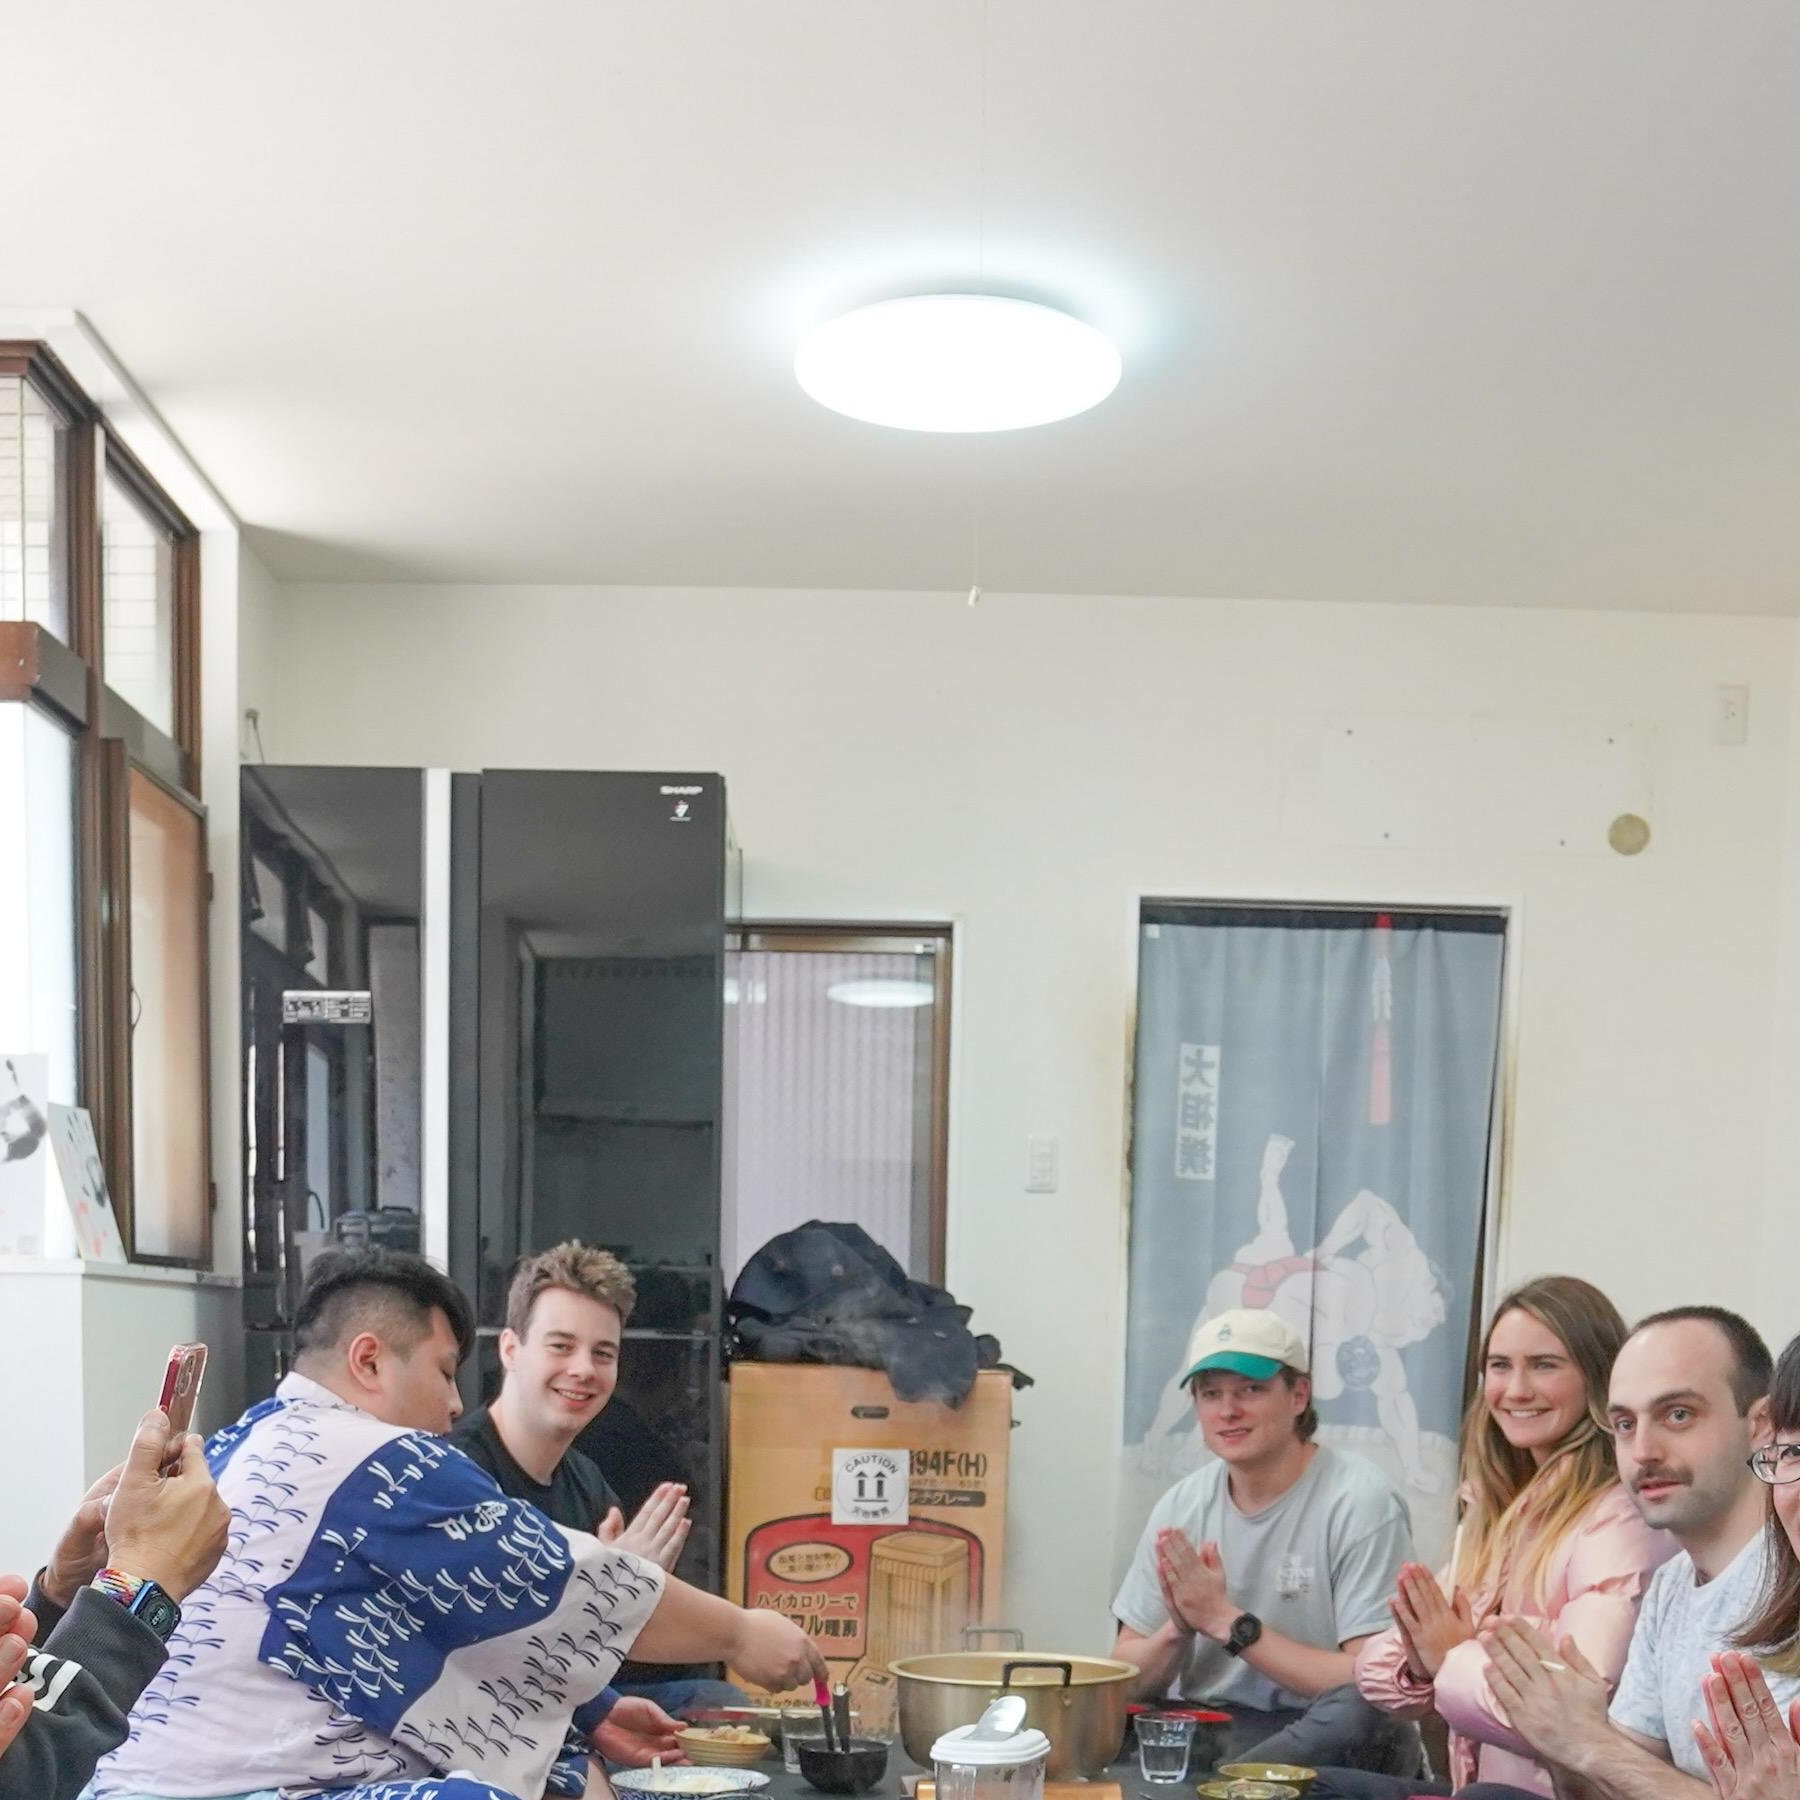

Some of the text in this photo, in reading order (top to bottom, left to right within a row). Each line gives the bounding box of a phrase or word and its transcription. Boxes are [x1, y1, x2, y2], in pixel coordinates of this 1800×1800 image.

[845, 1455, 899, 1475] CAUTION
[757, 1593, 858, 1610] ハイカロリーで
